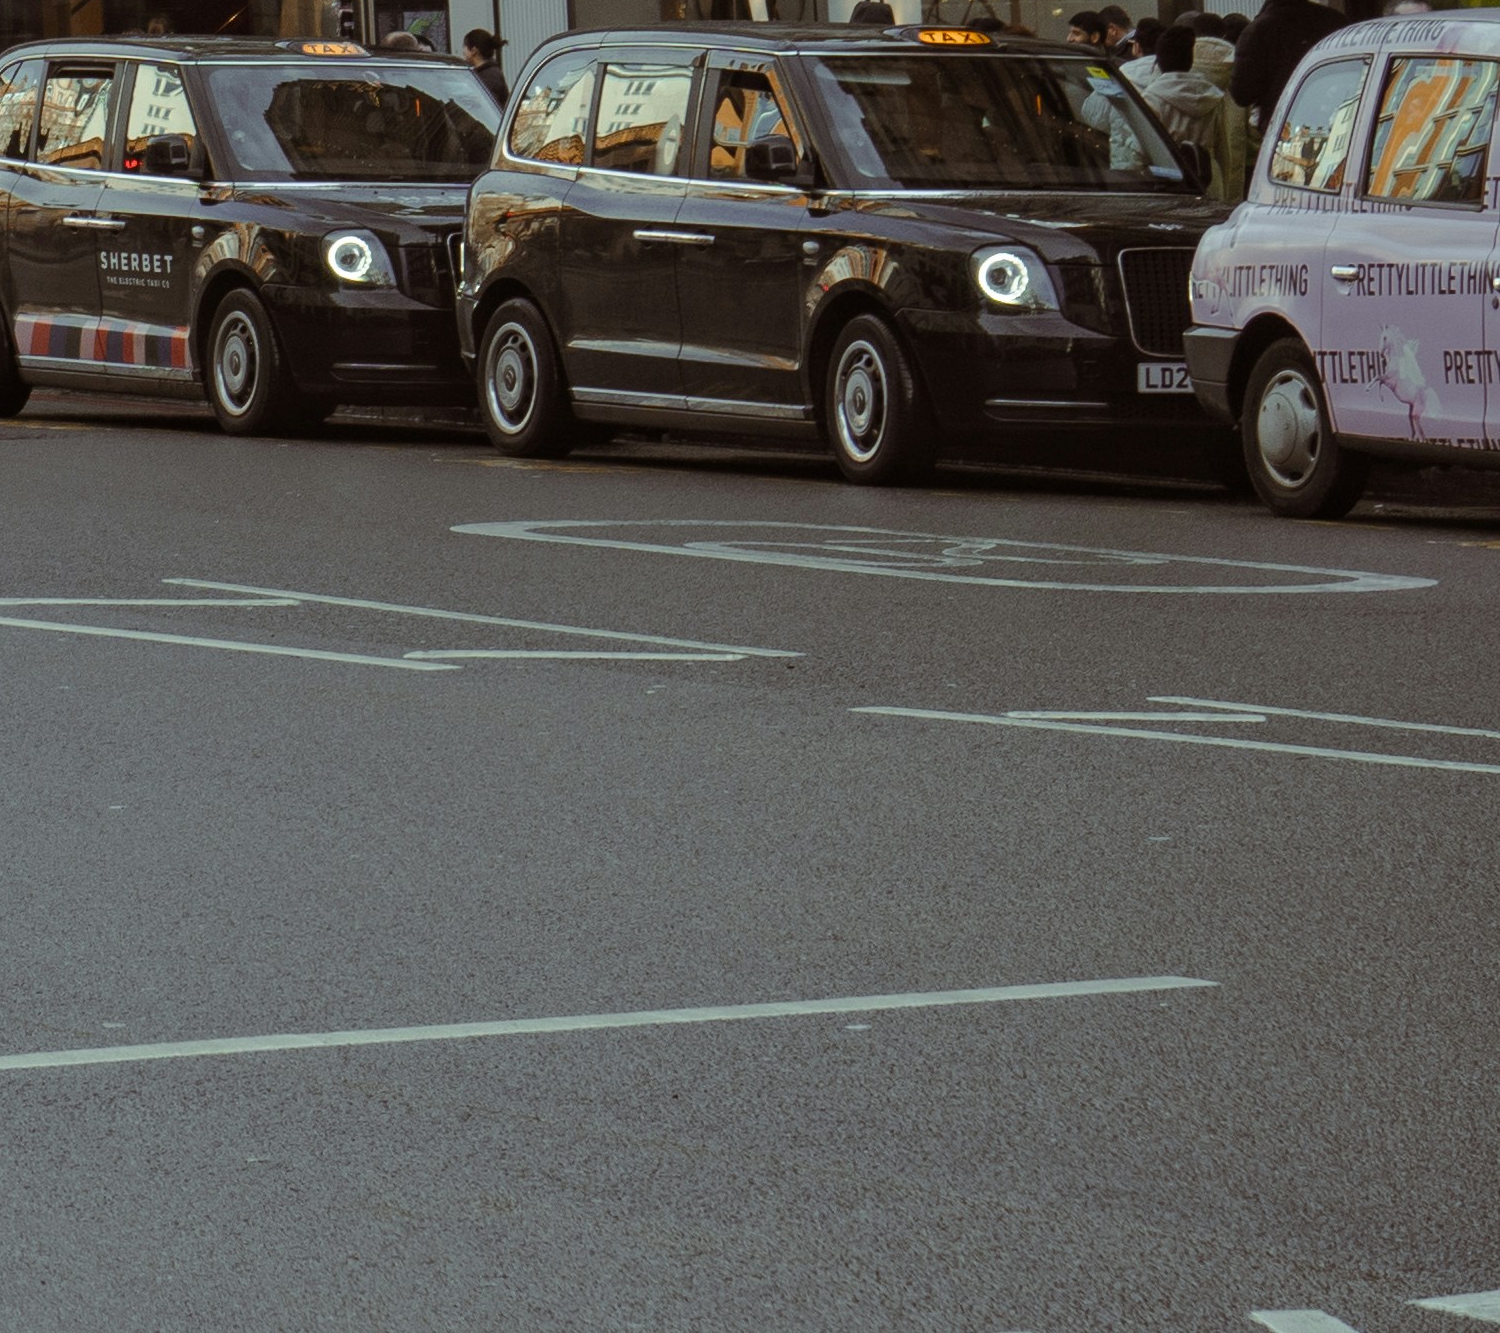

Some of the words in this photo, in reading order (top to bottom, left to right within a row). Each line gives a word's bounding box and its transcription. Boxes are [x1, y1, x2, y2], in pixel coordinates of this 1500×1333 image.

[924, 30, 988, 44] TAXI
[100, 251, 174, 273] SHERBET
[107, 276, 117, 284] THE
[119, 277, 146, 286] ELECTRIC
[1145, 366, 1189, 389] LD2
